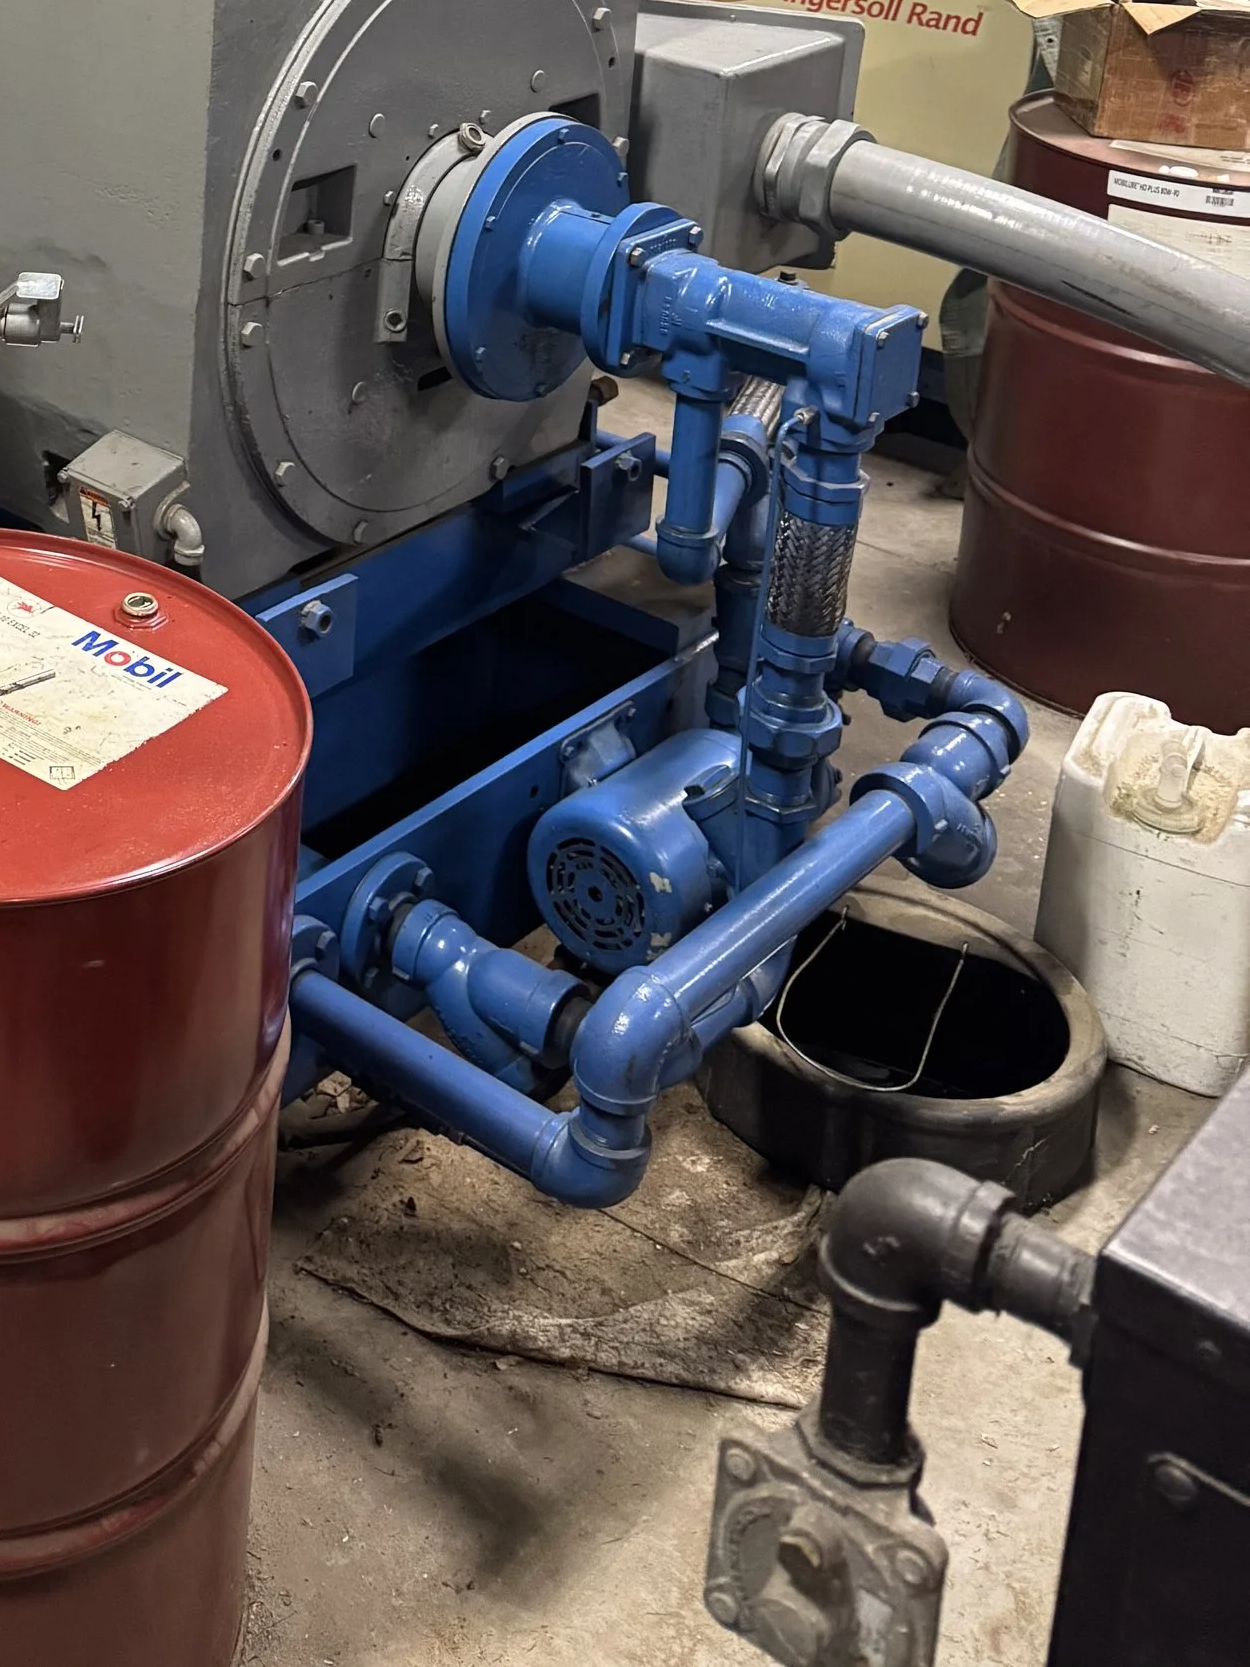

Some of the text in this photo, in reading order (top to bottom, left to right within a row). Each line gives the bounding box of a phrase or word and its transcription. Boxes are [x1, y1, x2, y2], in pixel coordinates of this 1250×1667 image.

[908, 3, 984, 37] Rand
[1147, 184, 1160, 194] PLUS
[71, 630, 184, 690] Mobil
